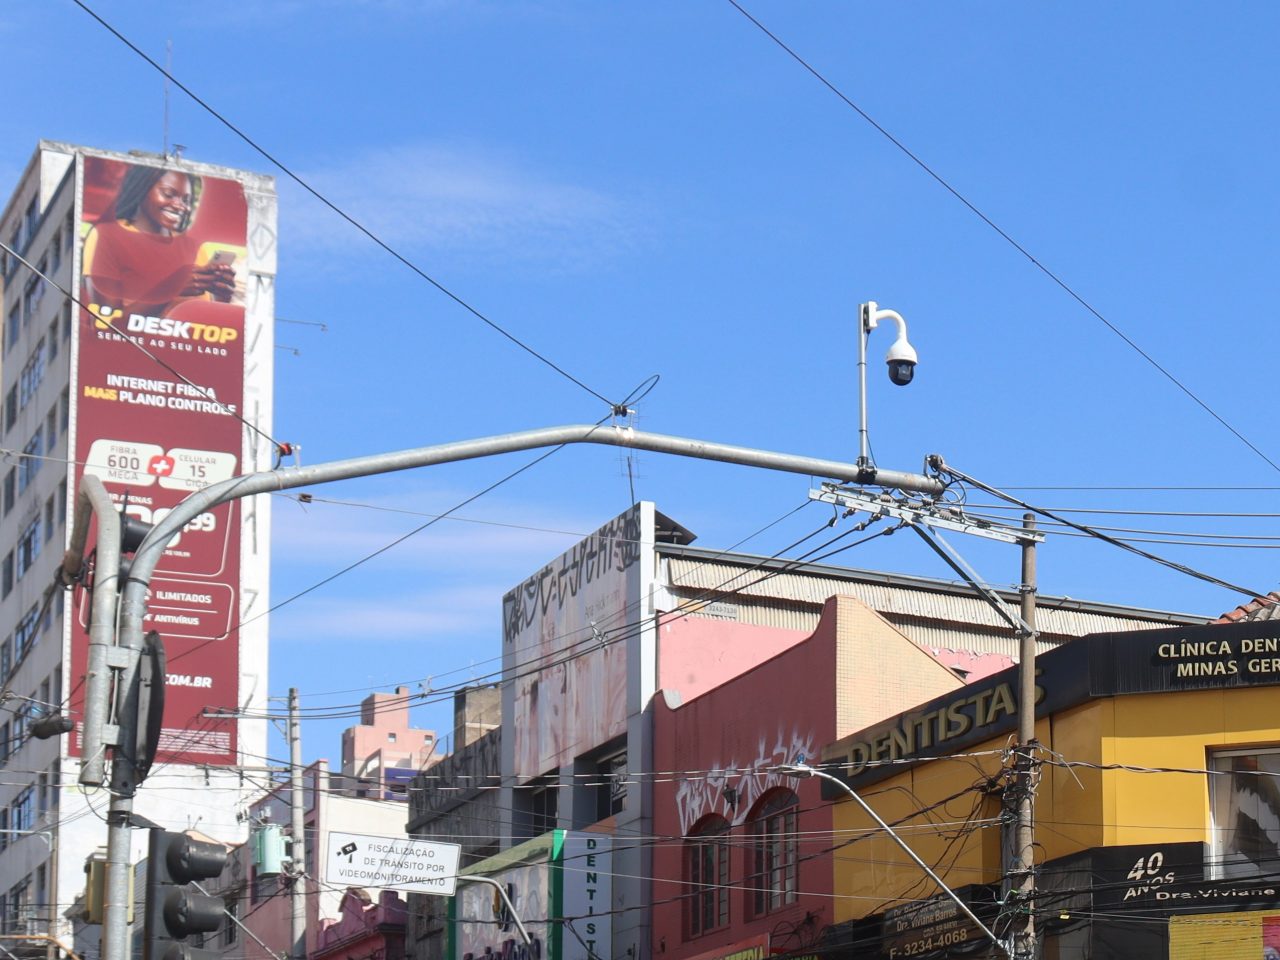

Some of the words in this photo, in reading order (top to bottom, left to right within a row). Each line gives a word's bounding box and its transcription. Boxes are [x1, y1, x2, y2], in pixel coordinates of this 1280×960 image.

[127, 314, 237, 344] DESKTOP
[97, 331, 144, 345] SEMRE
[171, 342, 192, 351] SEU
[198, 346, 227, 356] LADO
[107, 374, 174, 393] INTERNET
[176, 384, 216, 398] FIBRA
[119, 391, 166, 407] PLANO
[167, 398, 237, 416] CONTROLE
[110, 445, 137, 455] FIBRA
[107, 455, 140, 470] 600
[179, 454, 216, 465] CELULAR
[108, 470, 139, 481] MEGA
[190, 465, 206, 478] 15
[156, 591, 212, 604] ILIMITADOS
[154, 614, 199, 625] ANTIVÍRUS
[1158, 638, 1231, 658] CLÍNICA
[1177, 659, 1238, 678] MINAS
[368, 844, 435, 858] FISCALIZAÇÃO
[364, 857, 376, 866] DE
[380, 858, 424, 871] TRÂNSITO
[426, 864, 445, 873] POR
[1127, 852, 1164, 881] 40
[338, 869, 446, 887] VIDEOMONITORAMENTO
